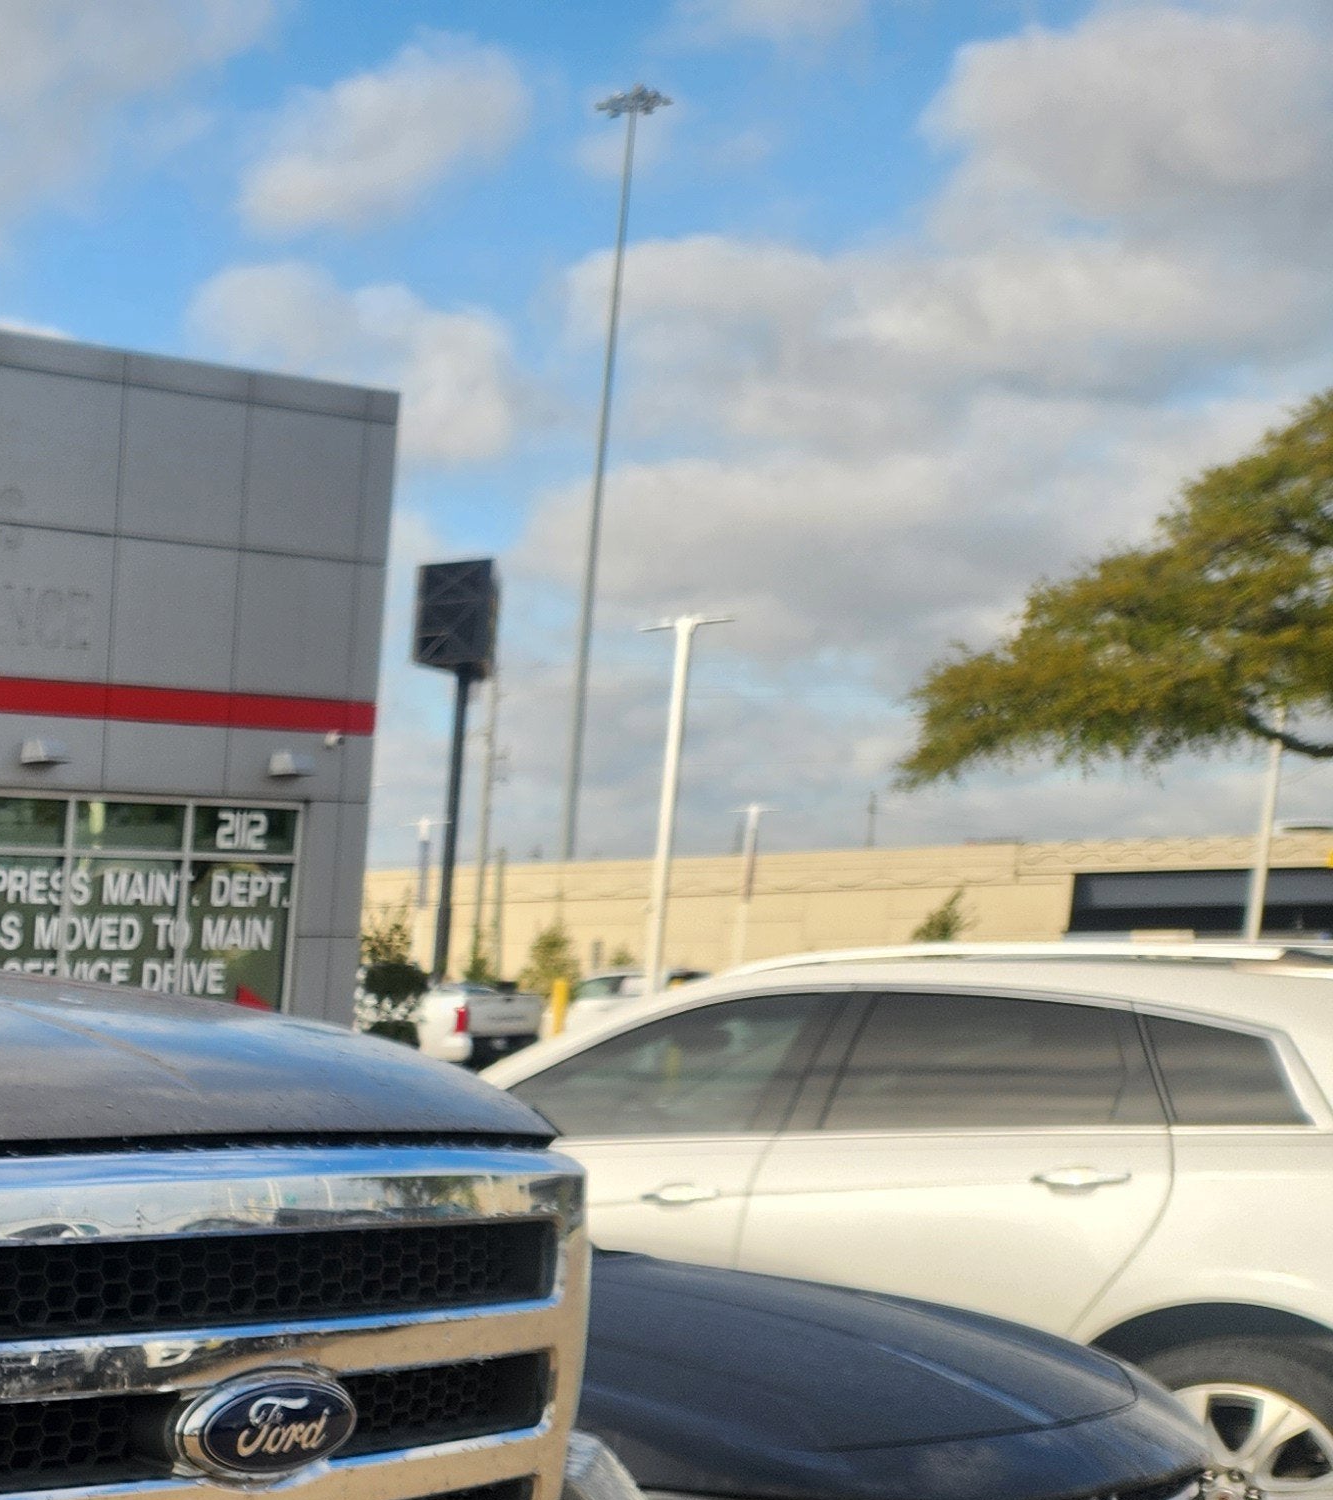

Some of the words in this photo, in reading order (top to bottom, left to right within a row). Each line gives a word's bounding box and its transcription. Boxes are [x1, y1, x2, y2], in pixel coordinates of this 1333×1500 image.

[33, 913, 142, 951] MOVED
[152, 914, 191, 951] TO
[201, 914, 273, 951] MAIN
[141, 959, 226, 995] DRIVE
[236, 1396, 331, 1458] Ford
